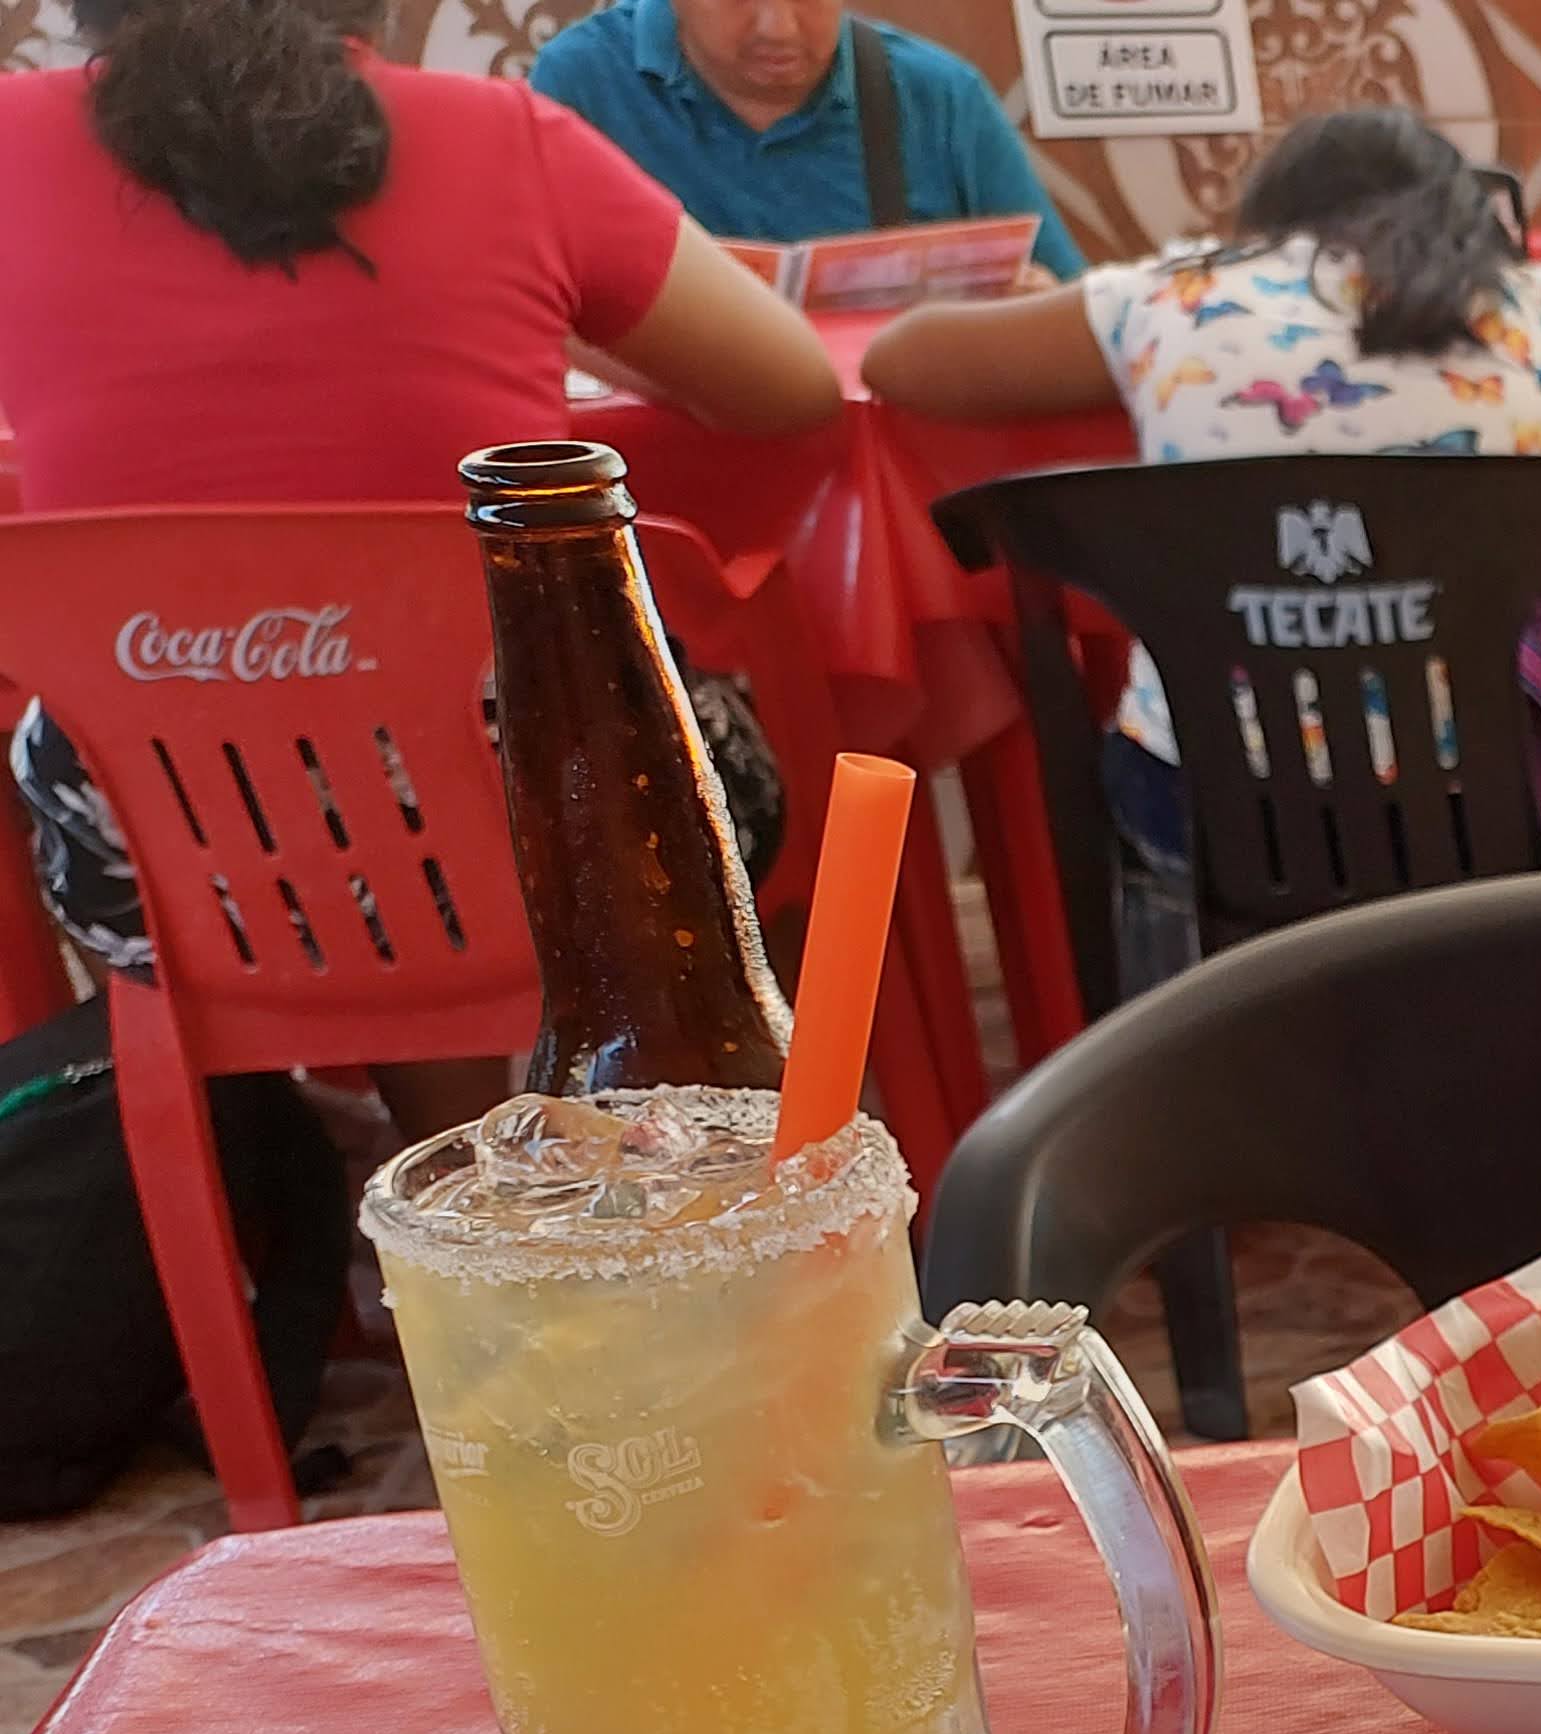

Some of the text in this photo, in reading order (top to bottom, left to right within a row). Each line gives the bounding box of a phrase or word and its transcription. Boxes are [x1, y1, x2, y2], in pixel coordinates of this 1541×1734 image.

[1065, 81, 1218, 107] DE FUMAR
[115, 603, 352, 682] Coca-Cola
[1227, 580, 1438, 648] TECATE
